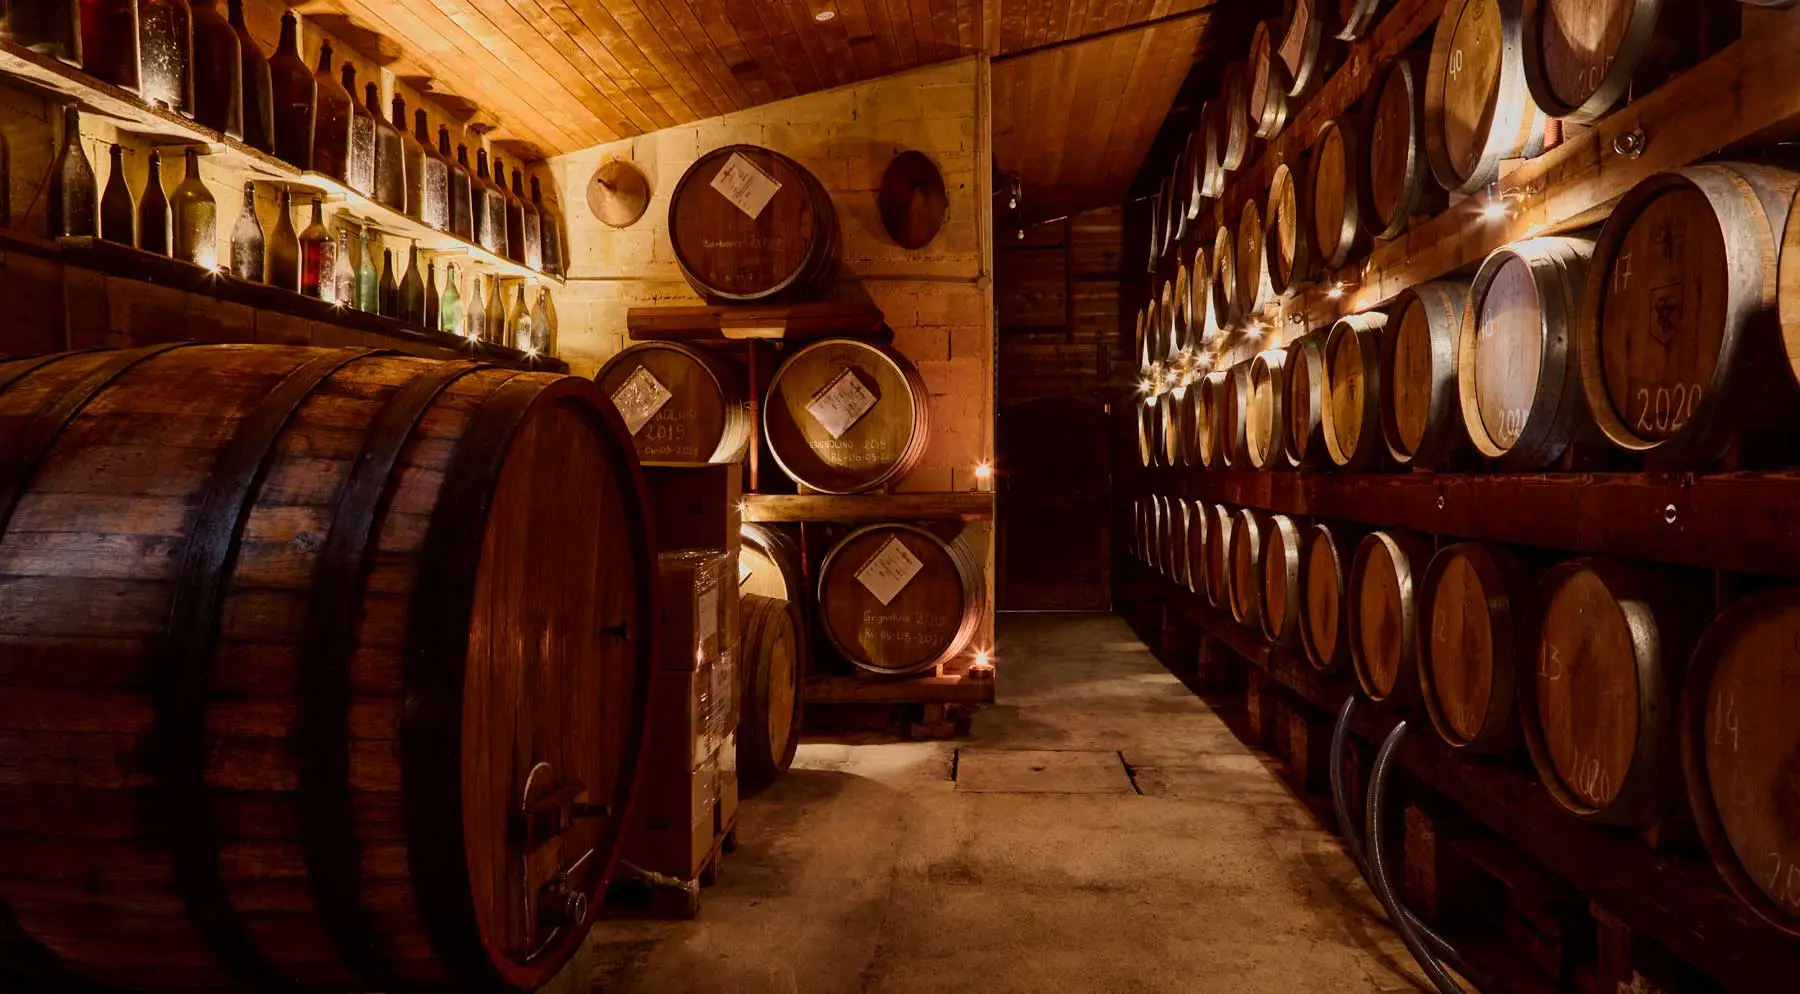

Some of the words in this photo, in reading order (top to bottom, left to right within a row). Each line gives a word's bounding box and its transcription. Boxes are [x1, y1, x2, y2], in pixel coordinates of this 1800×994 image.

[1450, 50, 1462, 80] 40
[1614, 252, 1633, 294] 17
[645, 424, 685, 440] 2019
[1537, 638, 1561, 680] 13
[1713, 690, 1738, 752] 14
